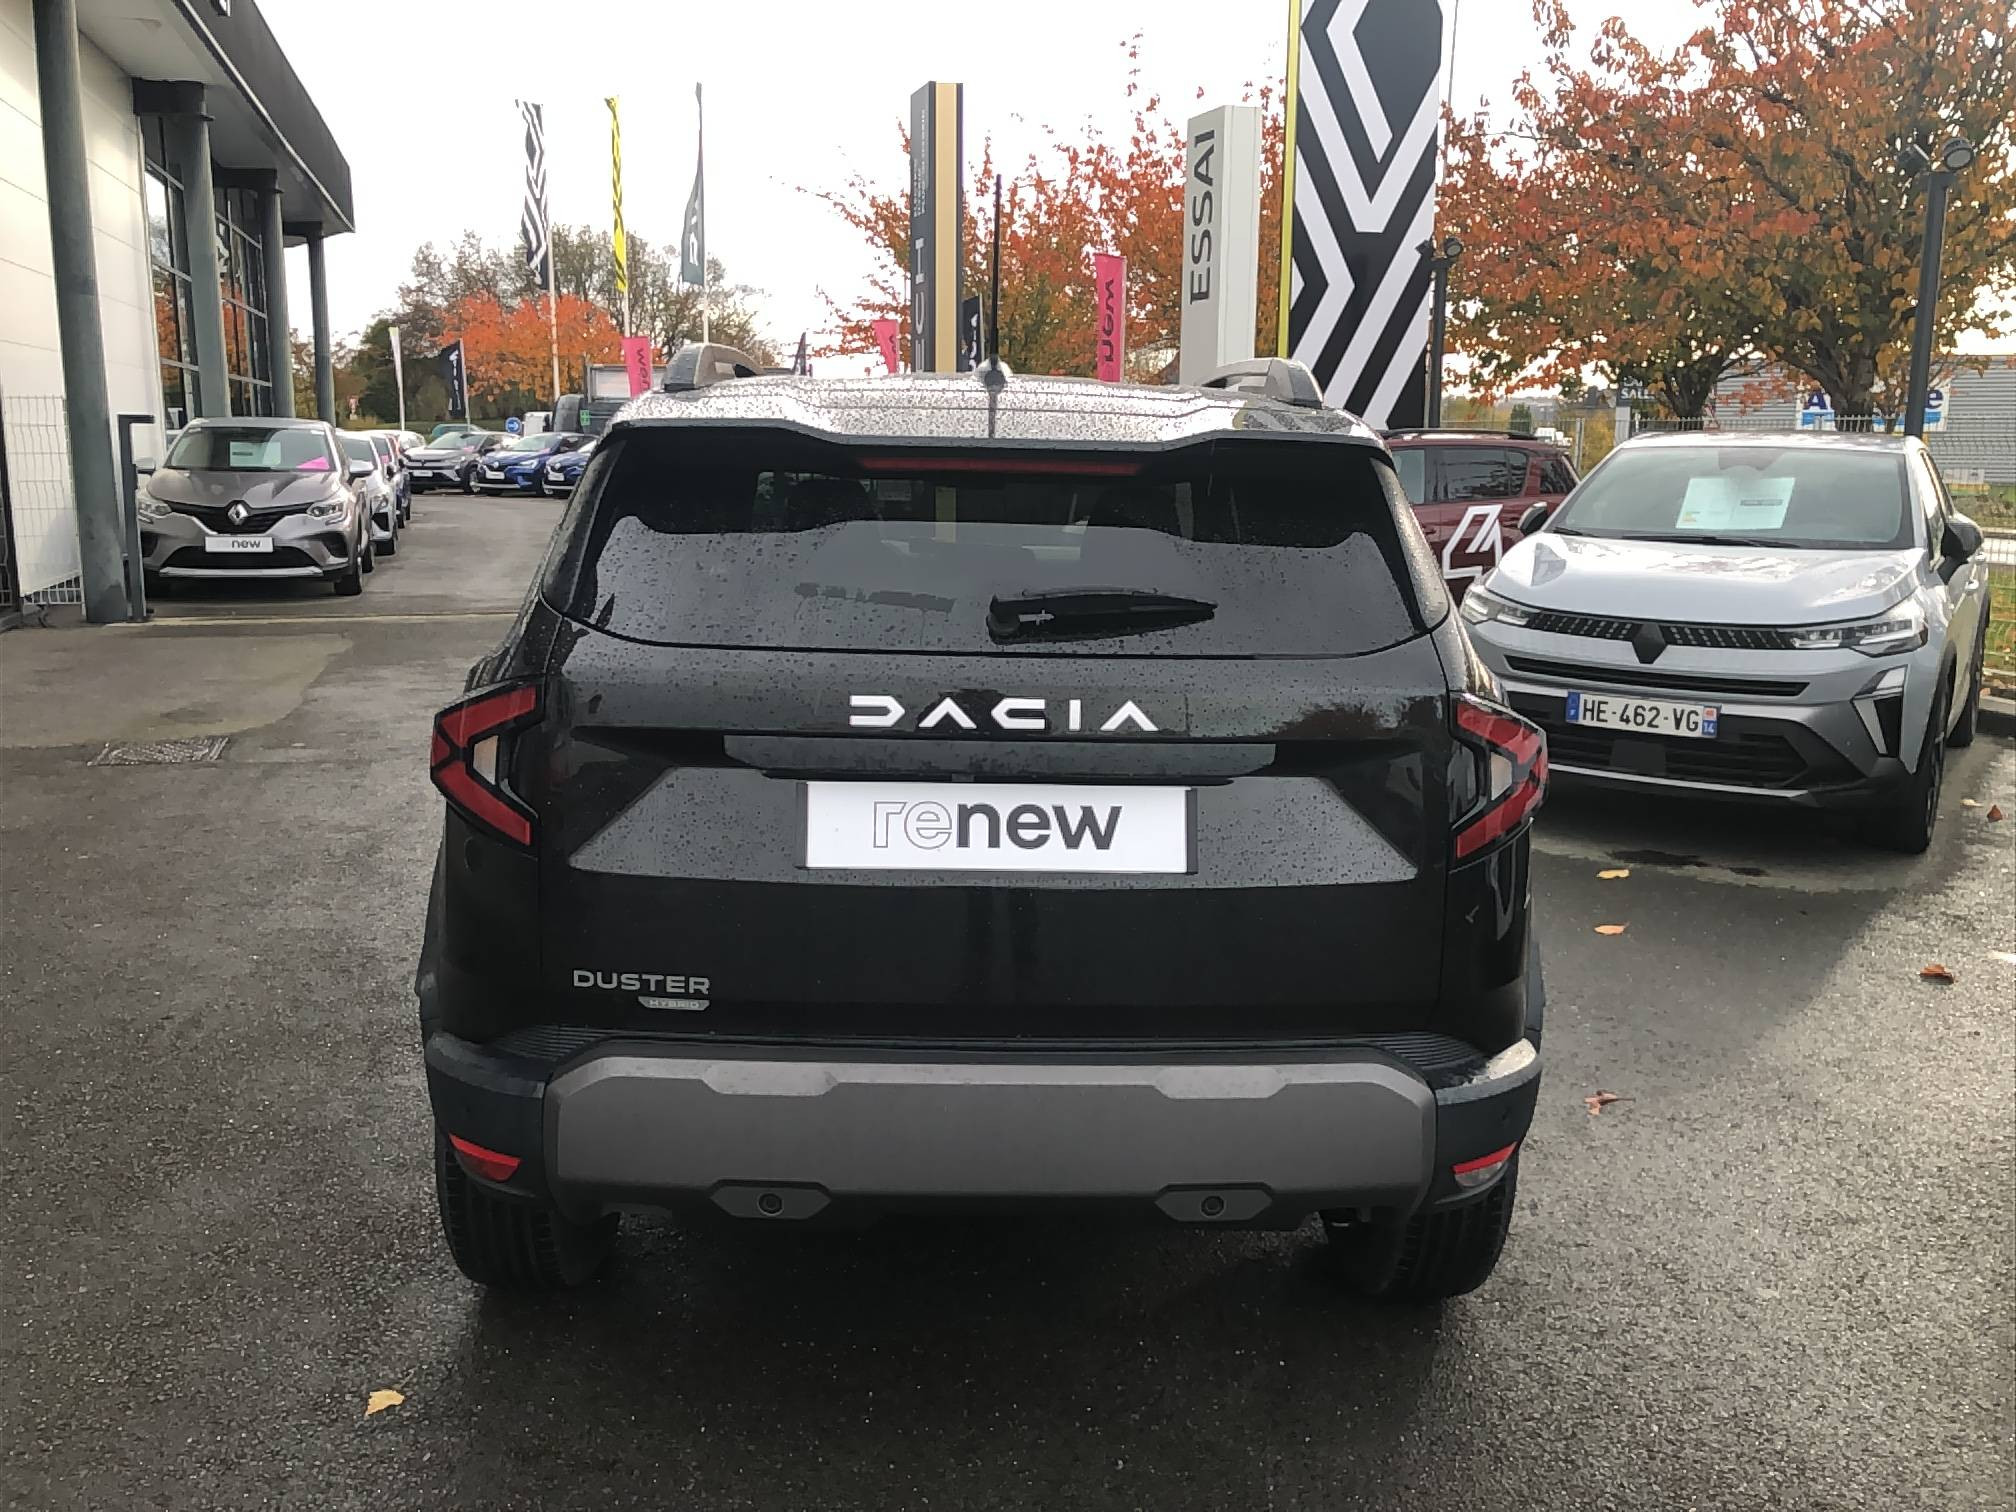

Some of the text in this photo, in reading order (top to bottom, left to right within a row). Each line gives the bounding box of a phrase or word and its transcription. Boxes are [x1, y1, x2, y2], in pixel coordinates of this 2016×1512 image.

[1190, 129, 1215, 305] ESSAI
[850, 695, 1159, 732] DACIA
[1582, 698, 1700, 732] HE-462-VG
[1703, 722, 1715, 734] 14
[873, 800, 1123, 850] renew
[573, 969, 711, 995] DUSTER
